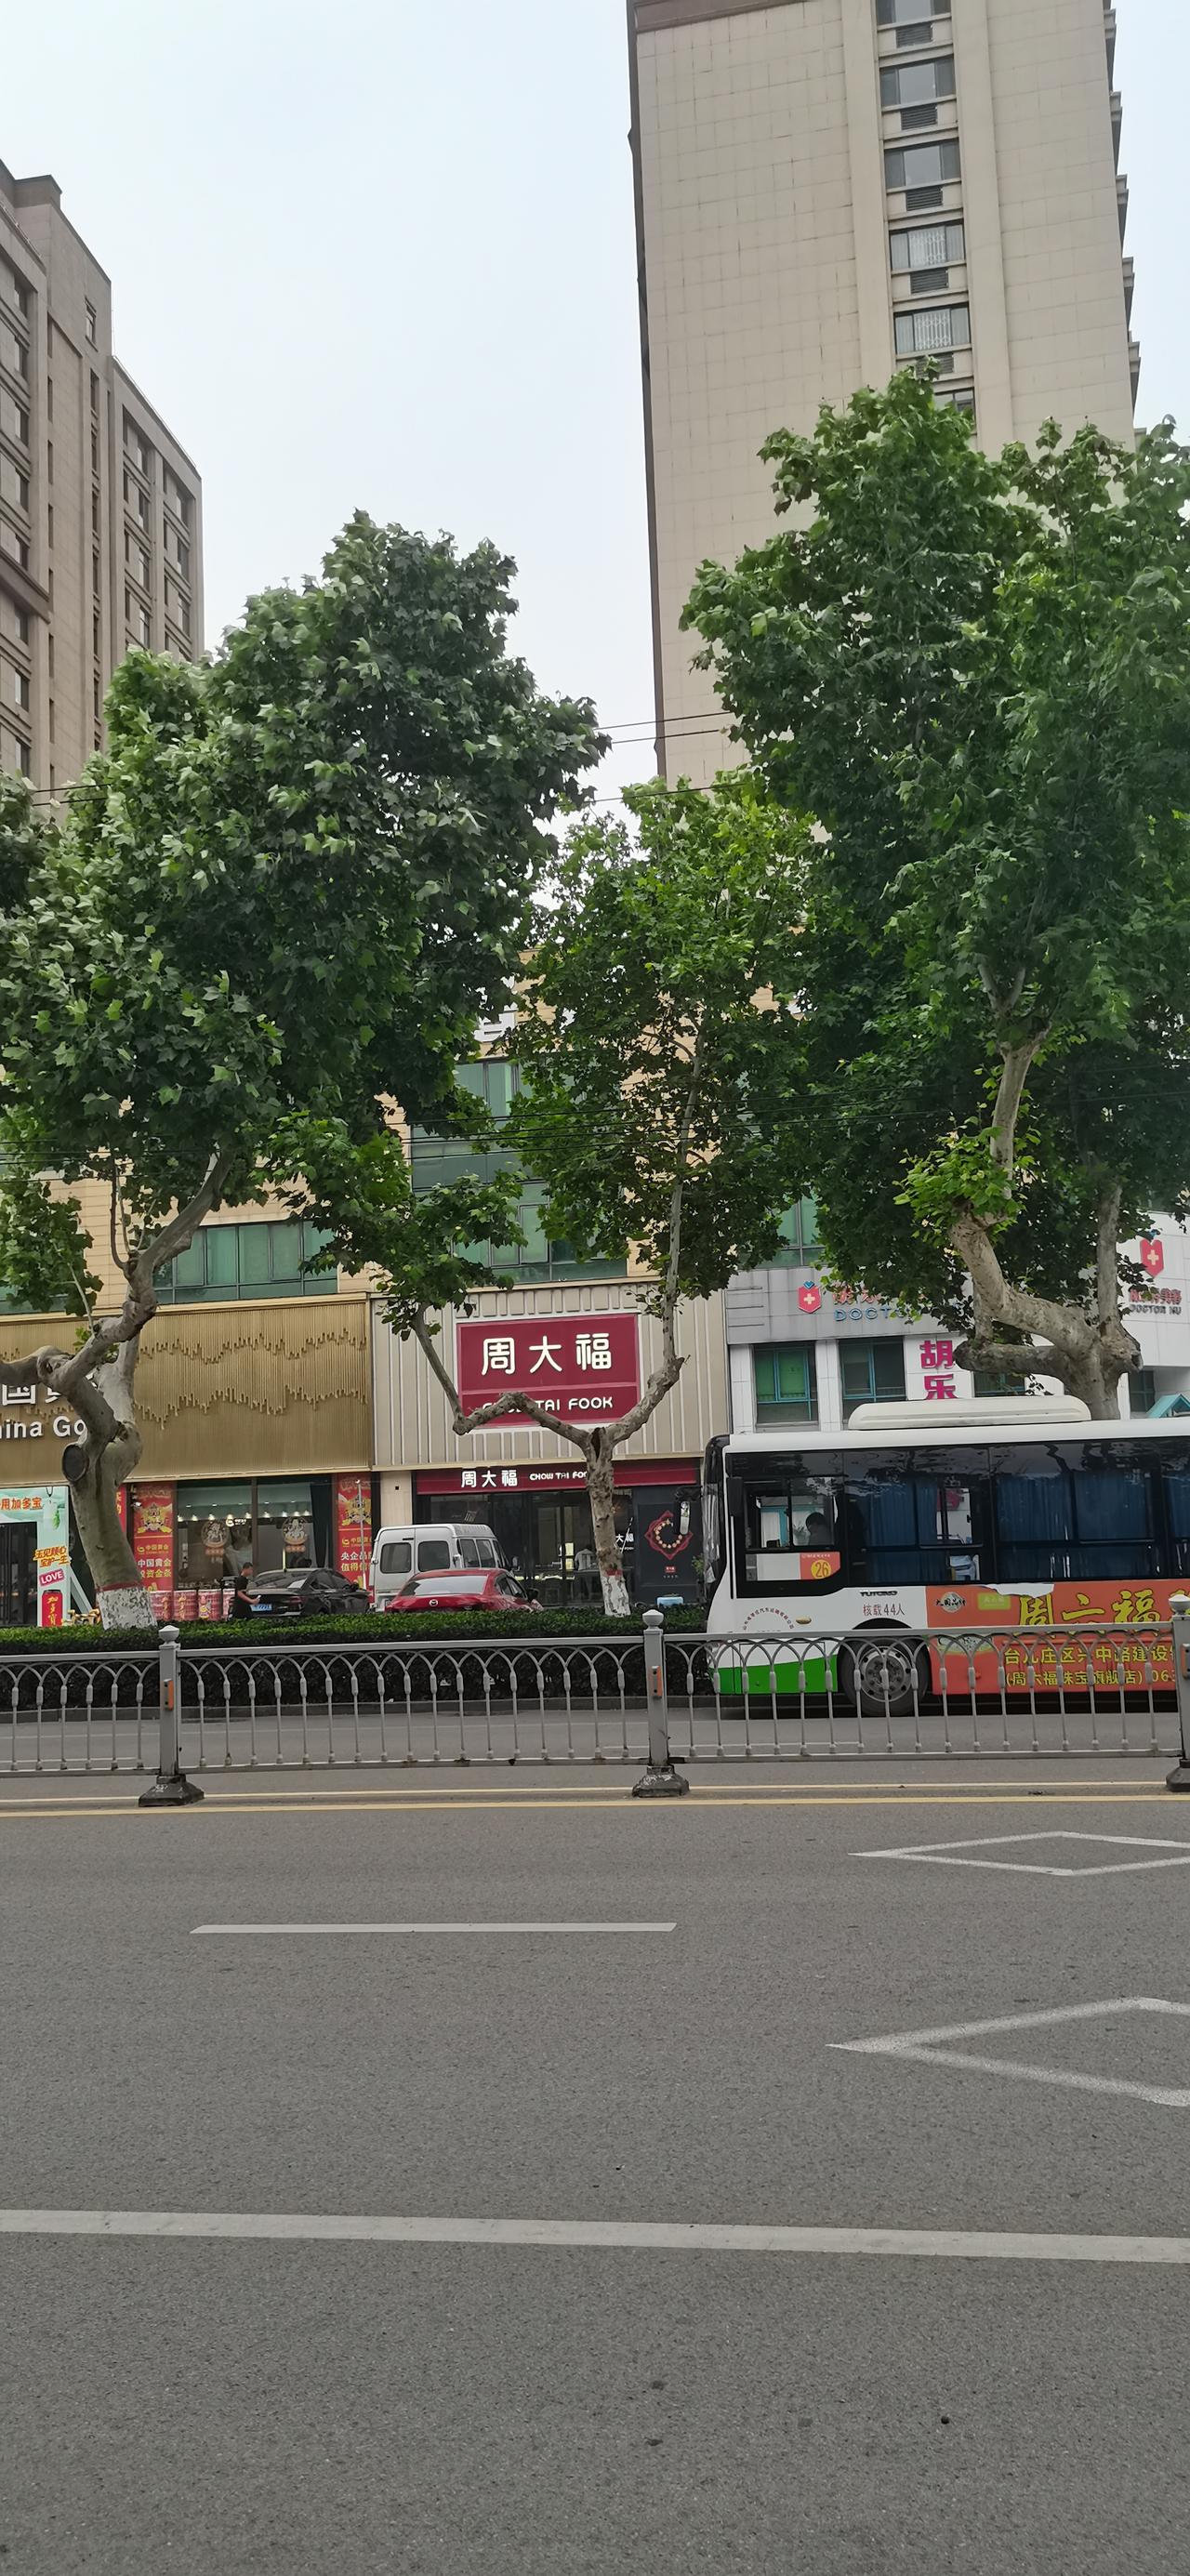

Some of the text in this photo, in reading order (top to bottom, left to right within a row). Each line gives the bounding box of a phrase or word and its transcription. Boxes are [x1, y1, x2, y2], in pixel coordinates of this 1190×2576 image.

[481, 1332, 612, 1376] 周大福
[919, 1340, 959, 1400] 胡乐
[535, 1399, 561, 1411] TAI
[568, 1396, 614, 1410] FOOK
[0, 1419, 44, 1439] ina
[461, 1470, 518, 1487] 周大福
[529, 1473, 554, 1481] CHOW
[555, 1472, 570, 1480] TAI
[0, 1498, 43, 1510] 用加多宝
[138, 1558, 172, 1568] 中国黄金
[815, 1562, 830, 1578] 26
[40, 1570, 64, 1585] LOVE
[863, 1603, 906, 1617] 核载44人
[1019, 1588, 1190, 1636] 周六福
[1004, 1646, 1175, 1665] 台儿庄区兴中路建设
